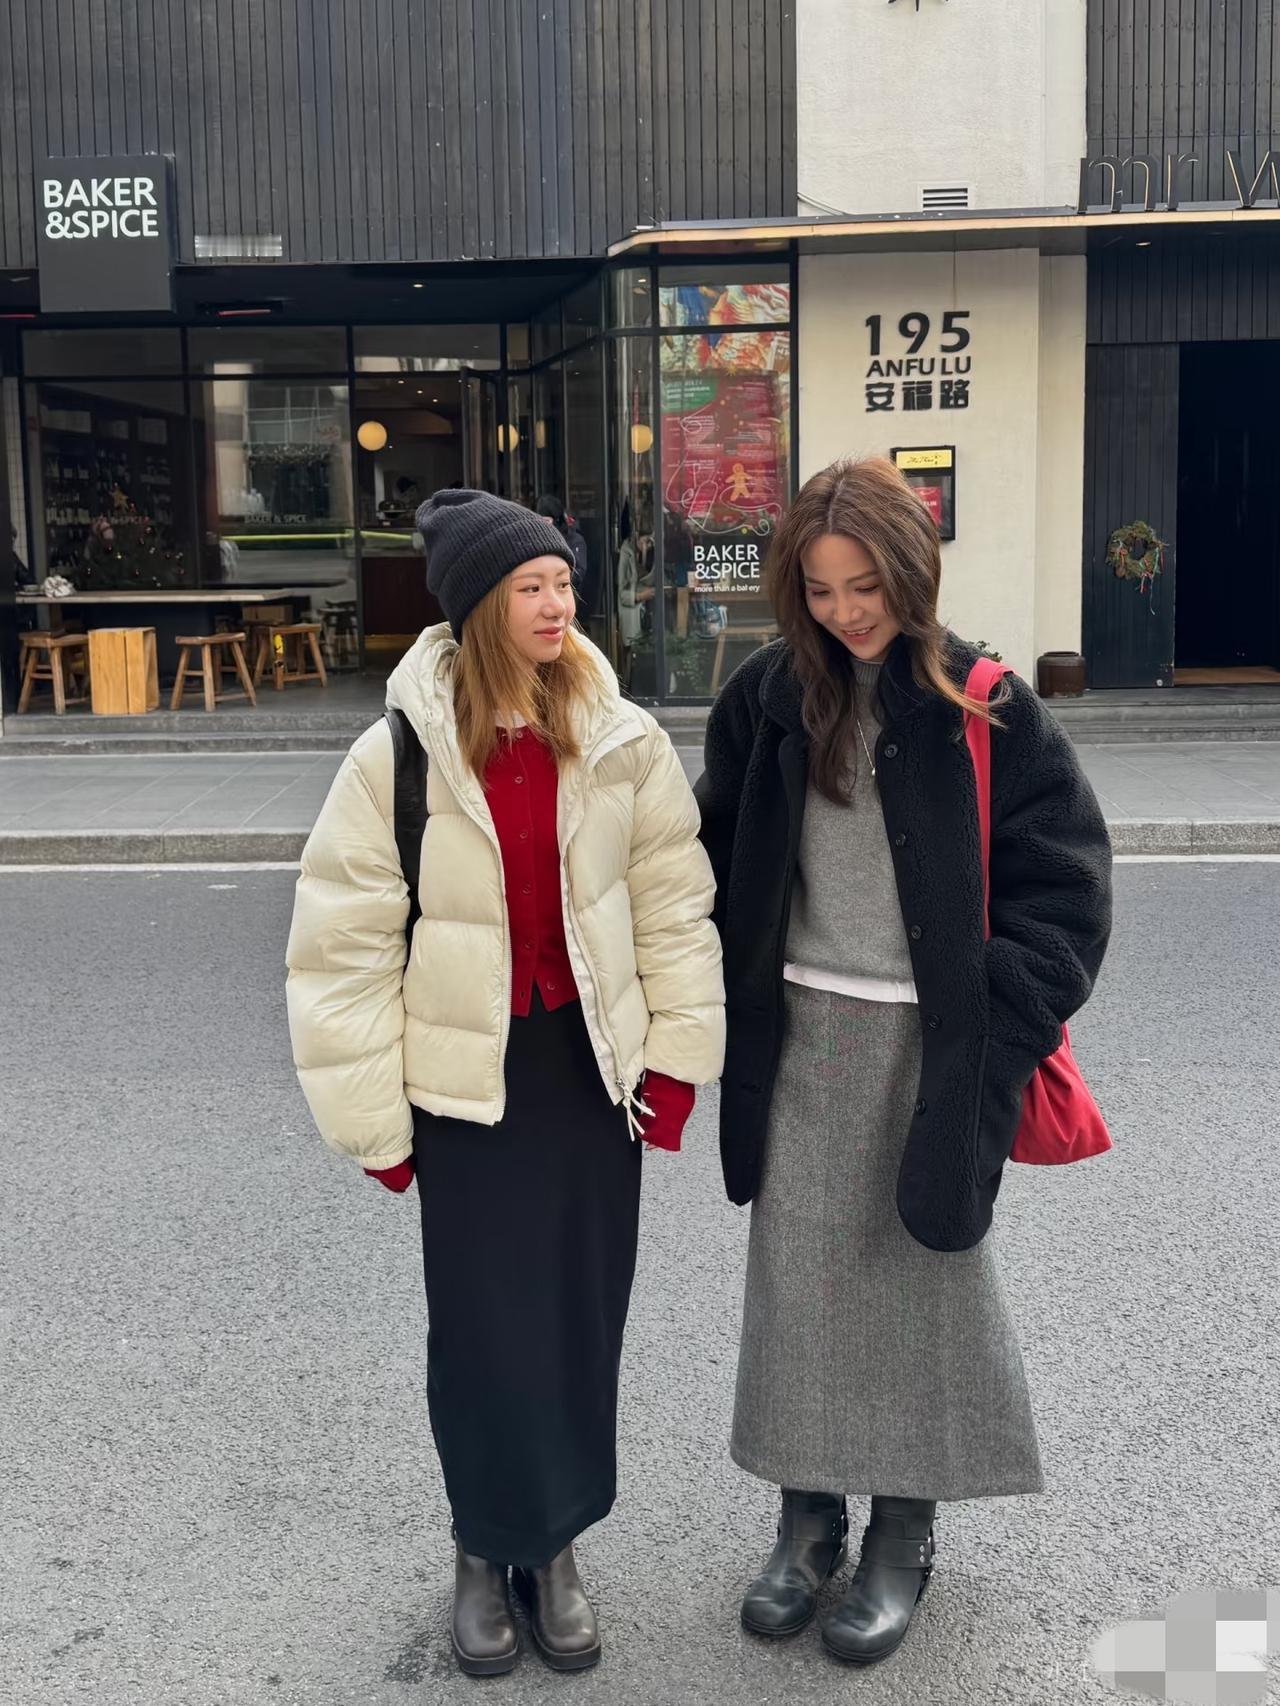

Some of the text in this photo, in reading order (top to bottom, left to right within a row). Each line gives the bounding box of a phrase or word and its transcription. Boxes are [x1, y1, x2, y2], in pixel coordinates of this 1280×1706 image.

[43, 177, 157, 208] BAKER
[1078, 152, 1199, 214] mr
[45, 209, 159, 239] &SPICE
[865, 311, 970, 356] 195
[865, 379, 970, 413] 安福路
[694, 544, 759, 561] BAKER
[695, 562, 760, 579] &SPICE
